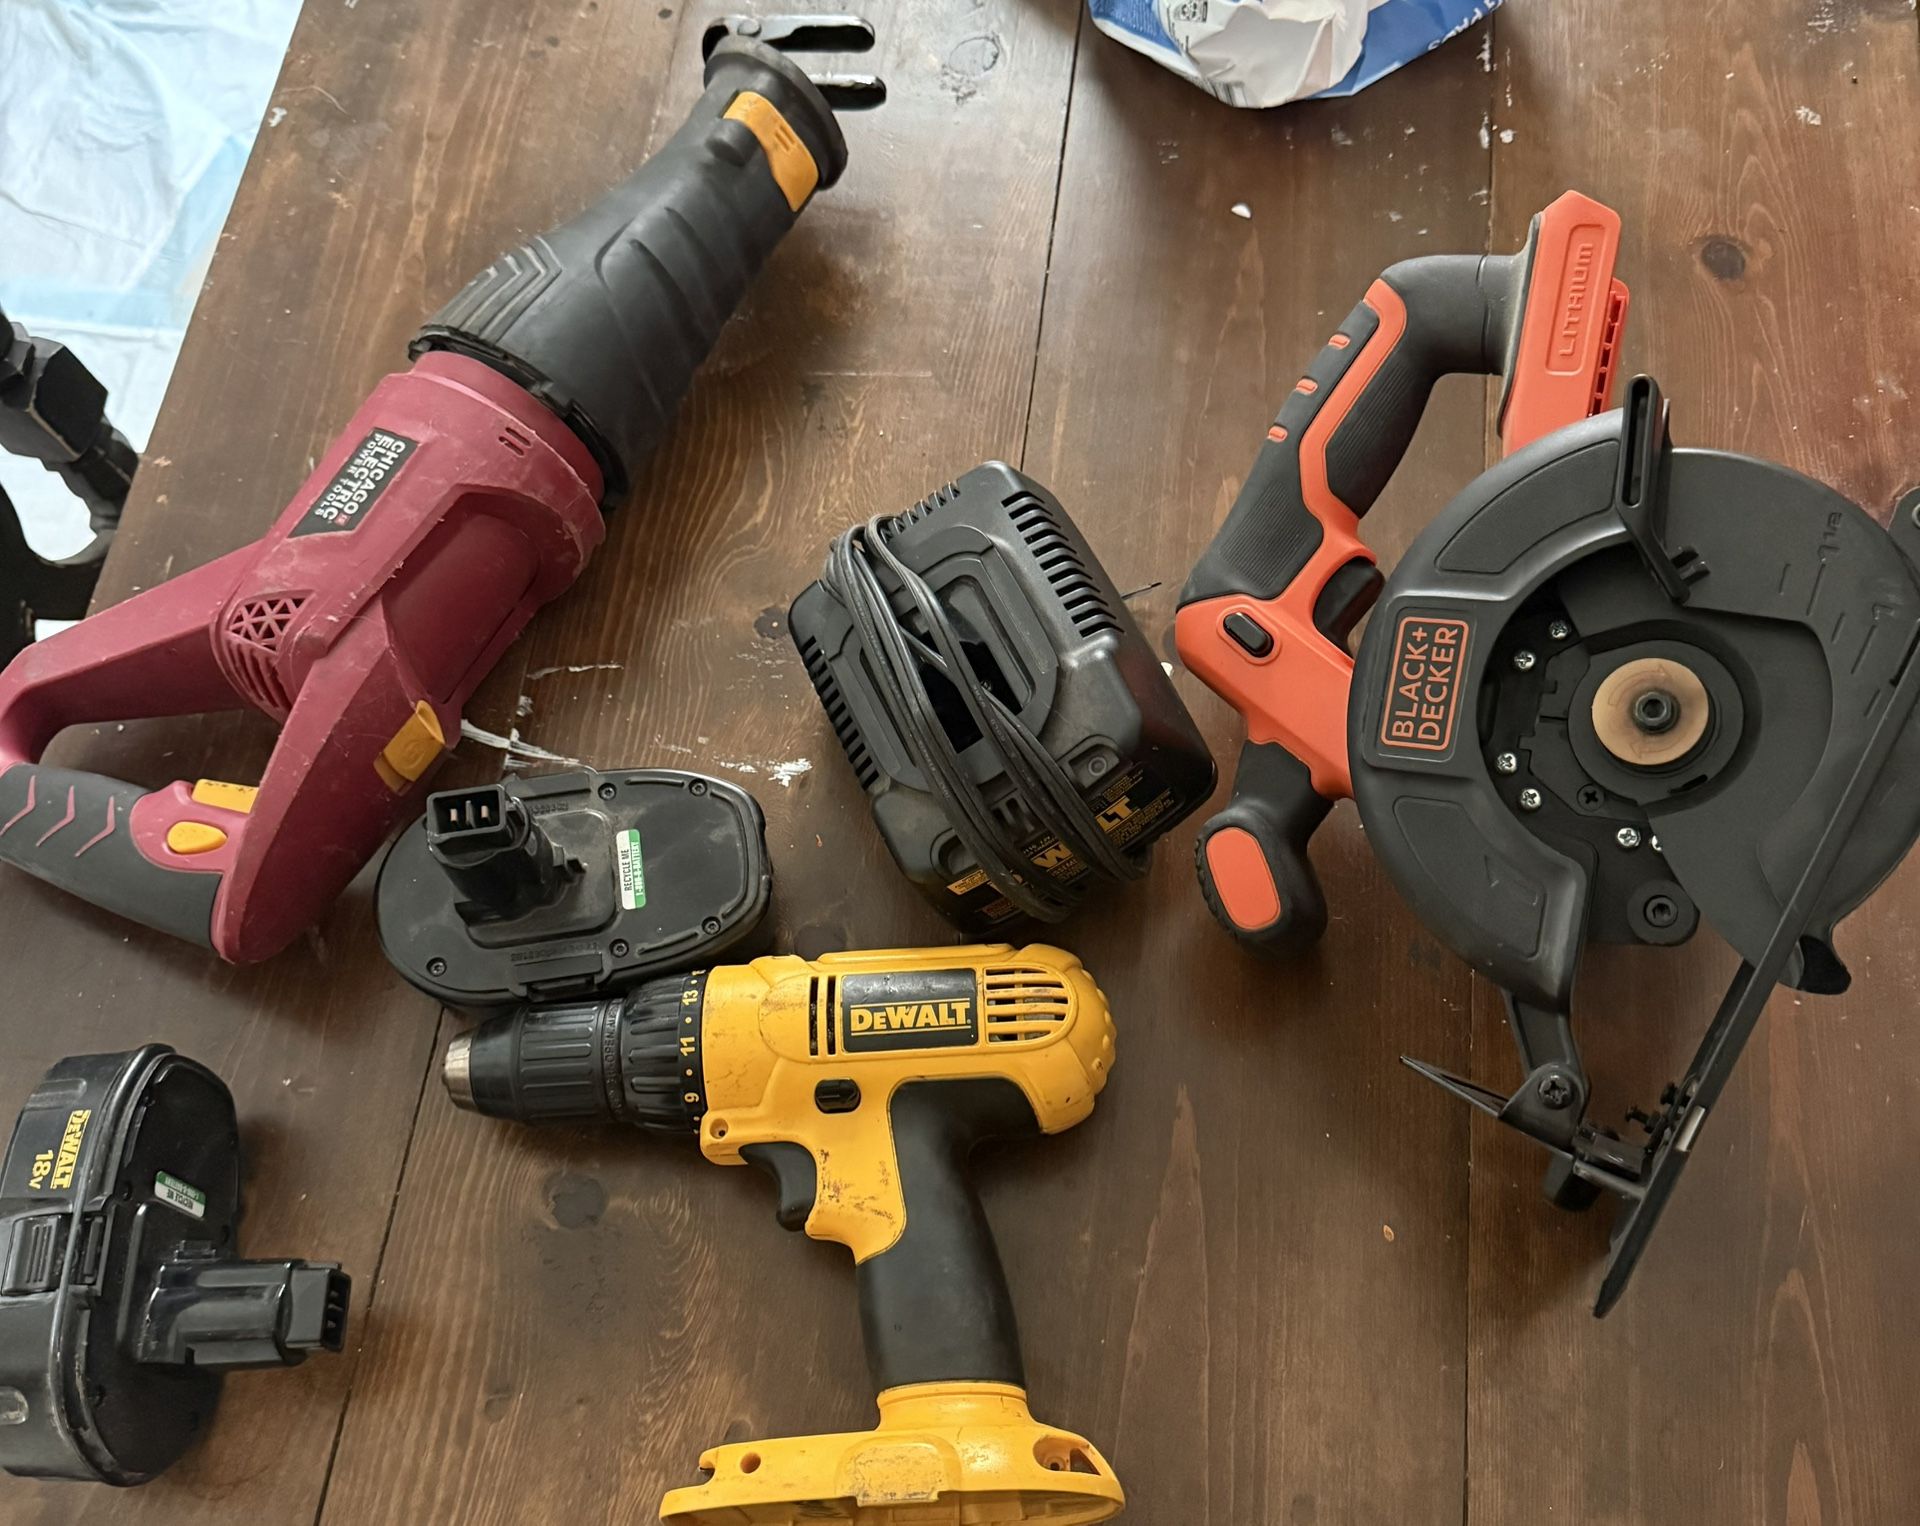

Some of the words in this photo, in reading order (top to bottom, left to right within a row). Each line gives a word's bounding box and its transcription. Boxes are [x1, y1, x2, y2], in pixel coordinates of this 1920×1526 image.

[346, 433, 383, 474] POWER
[321, 435, 395, 520] ELECTRIC
[343, 441, 406, 515] CHICAGO
[314, 477, 350, 516] TOOLS
[1391, 626, 1429, 739] BLACK+
[1417, 626, 1458, 741] DECKER
[620, 848, 631, 861] ME
[622, 861, 633, 892] RECYCLE
[681, 989, 699, 1007] 13
[849, 1001, 970, 1032] DEWALT
[679, 1036, 696, 1058] 11
[684, 1092, 700, 1104] 9
